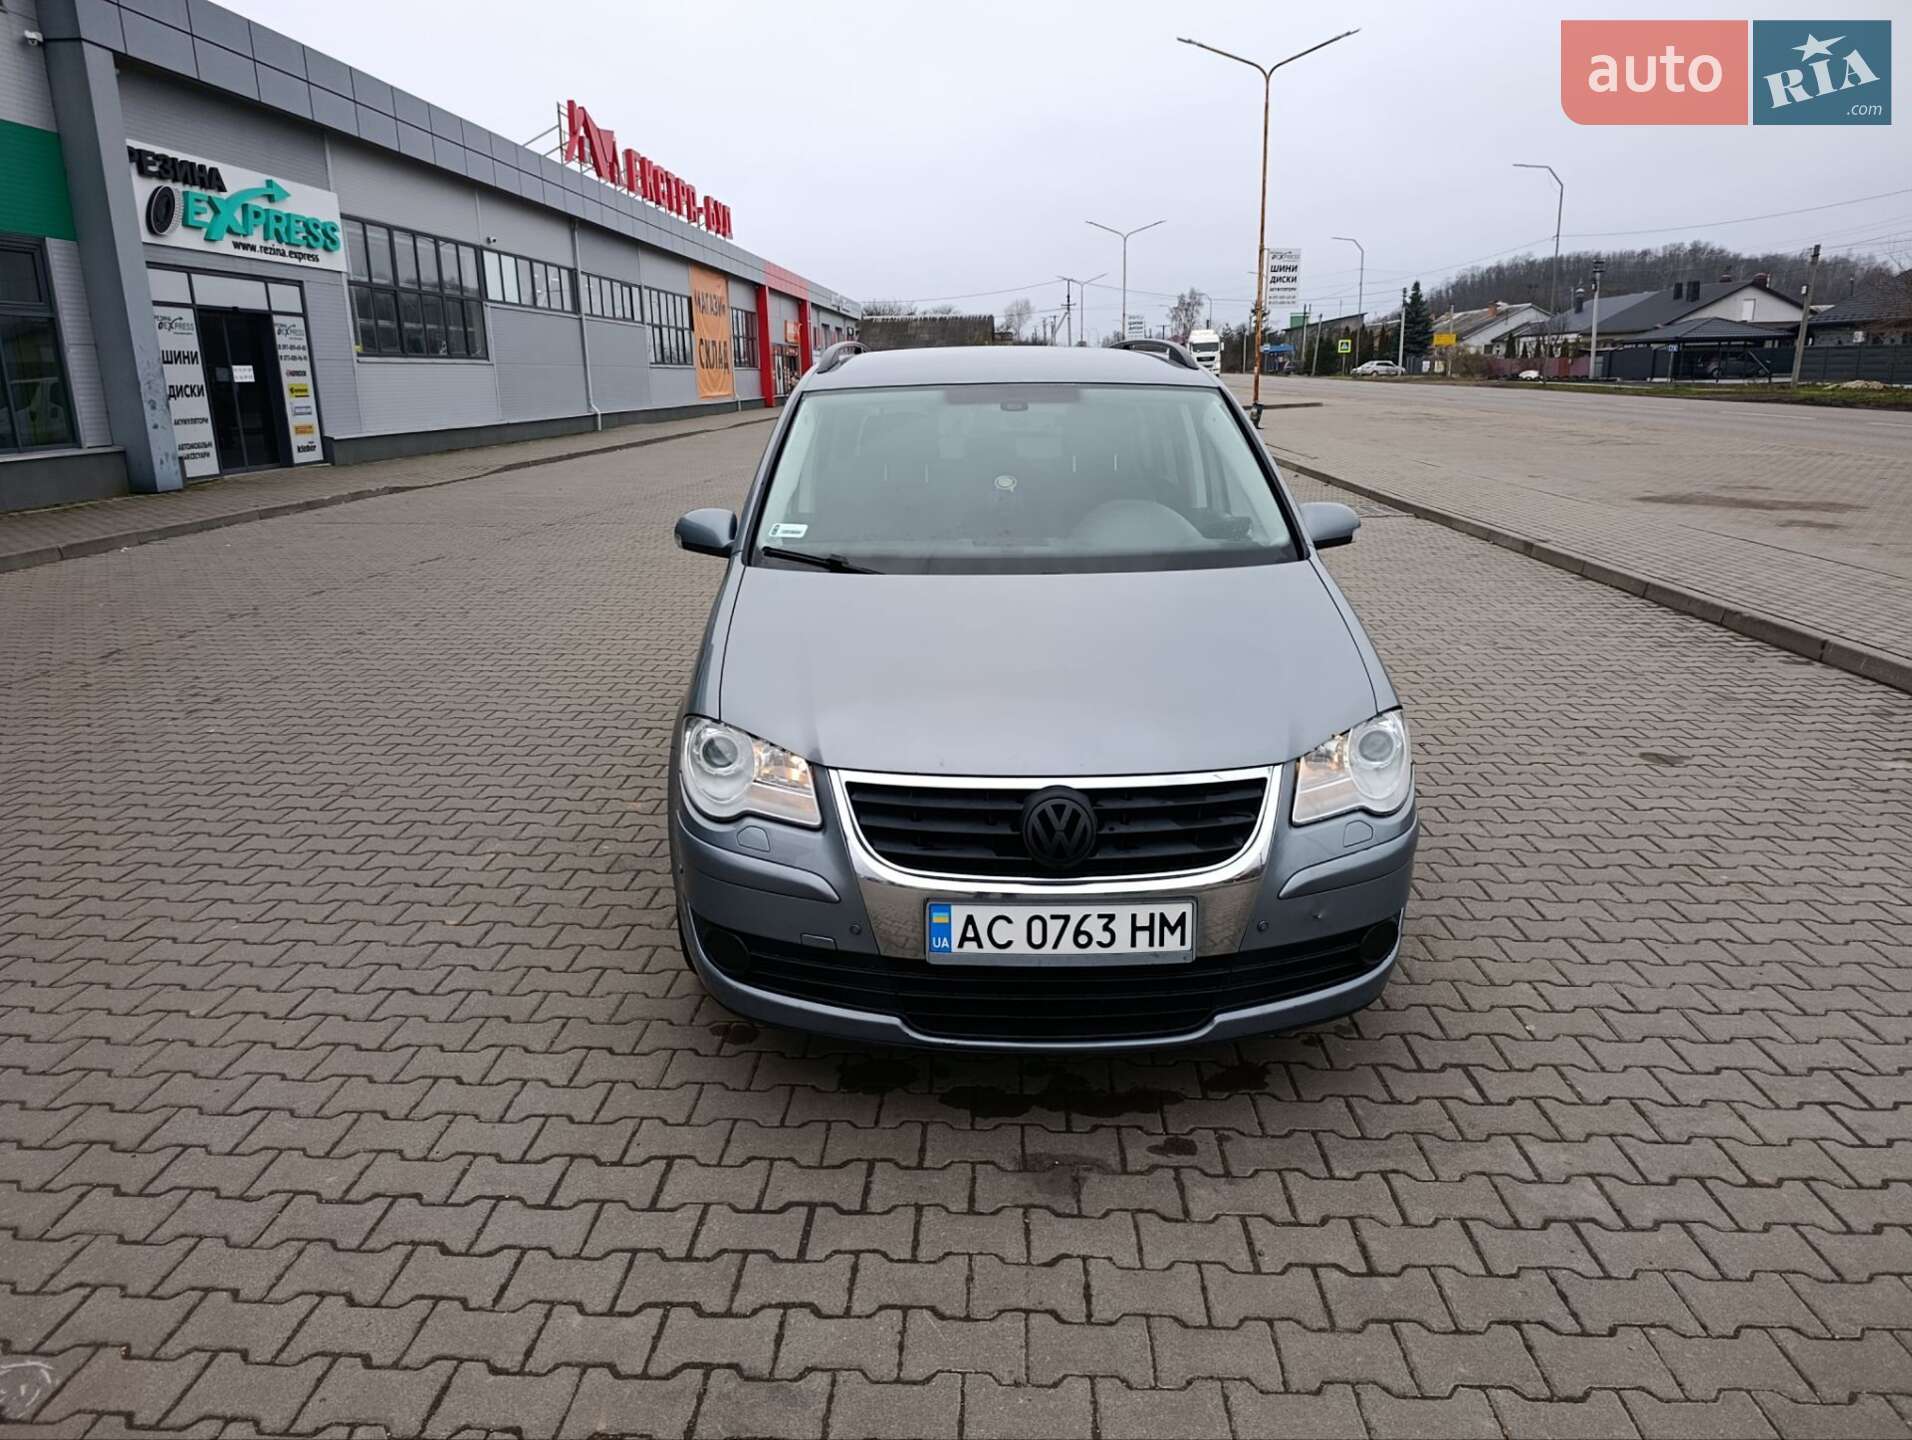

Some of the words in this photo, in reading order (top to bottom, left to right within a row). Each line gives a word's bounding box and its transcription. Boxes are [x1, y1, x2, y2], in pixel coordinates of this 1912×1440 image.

[182, 188, 341, 253] EXPRESS
[232, 240, 320, 263] www.rezina.express
[161, 349, 199, 365] ШИНИ
[698, 338, 730, 374] СКЛАД
[168, 383, 205, 401] ДИСКИ
[957, 913, 1014, 950] AC
[1026, 913, 1117, 950] 0763
[1130, 910, 1187, 949] HM
[932, 936, 950, 949] UA
